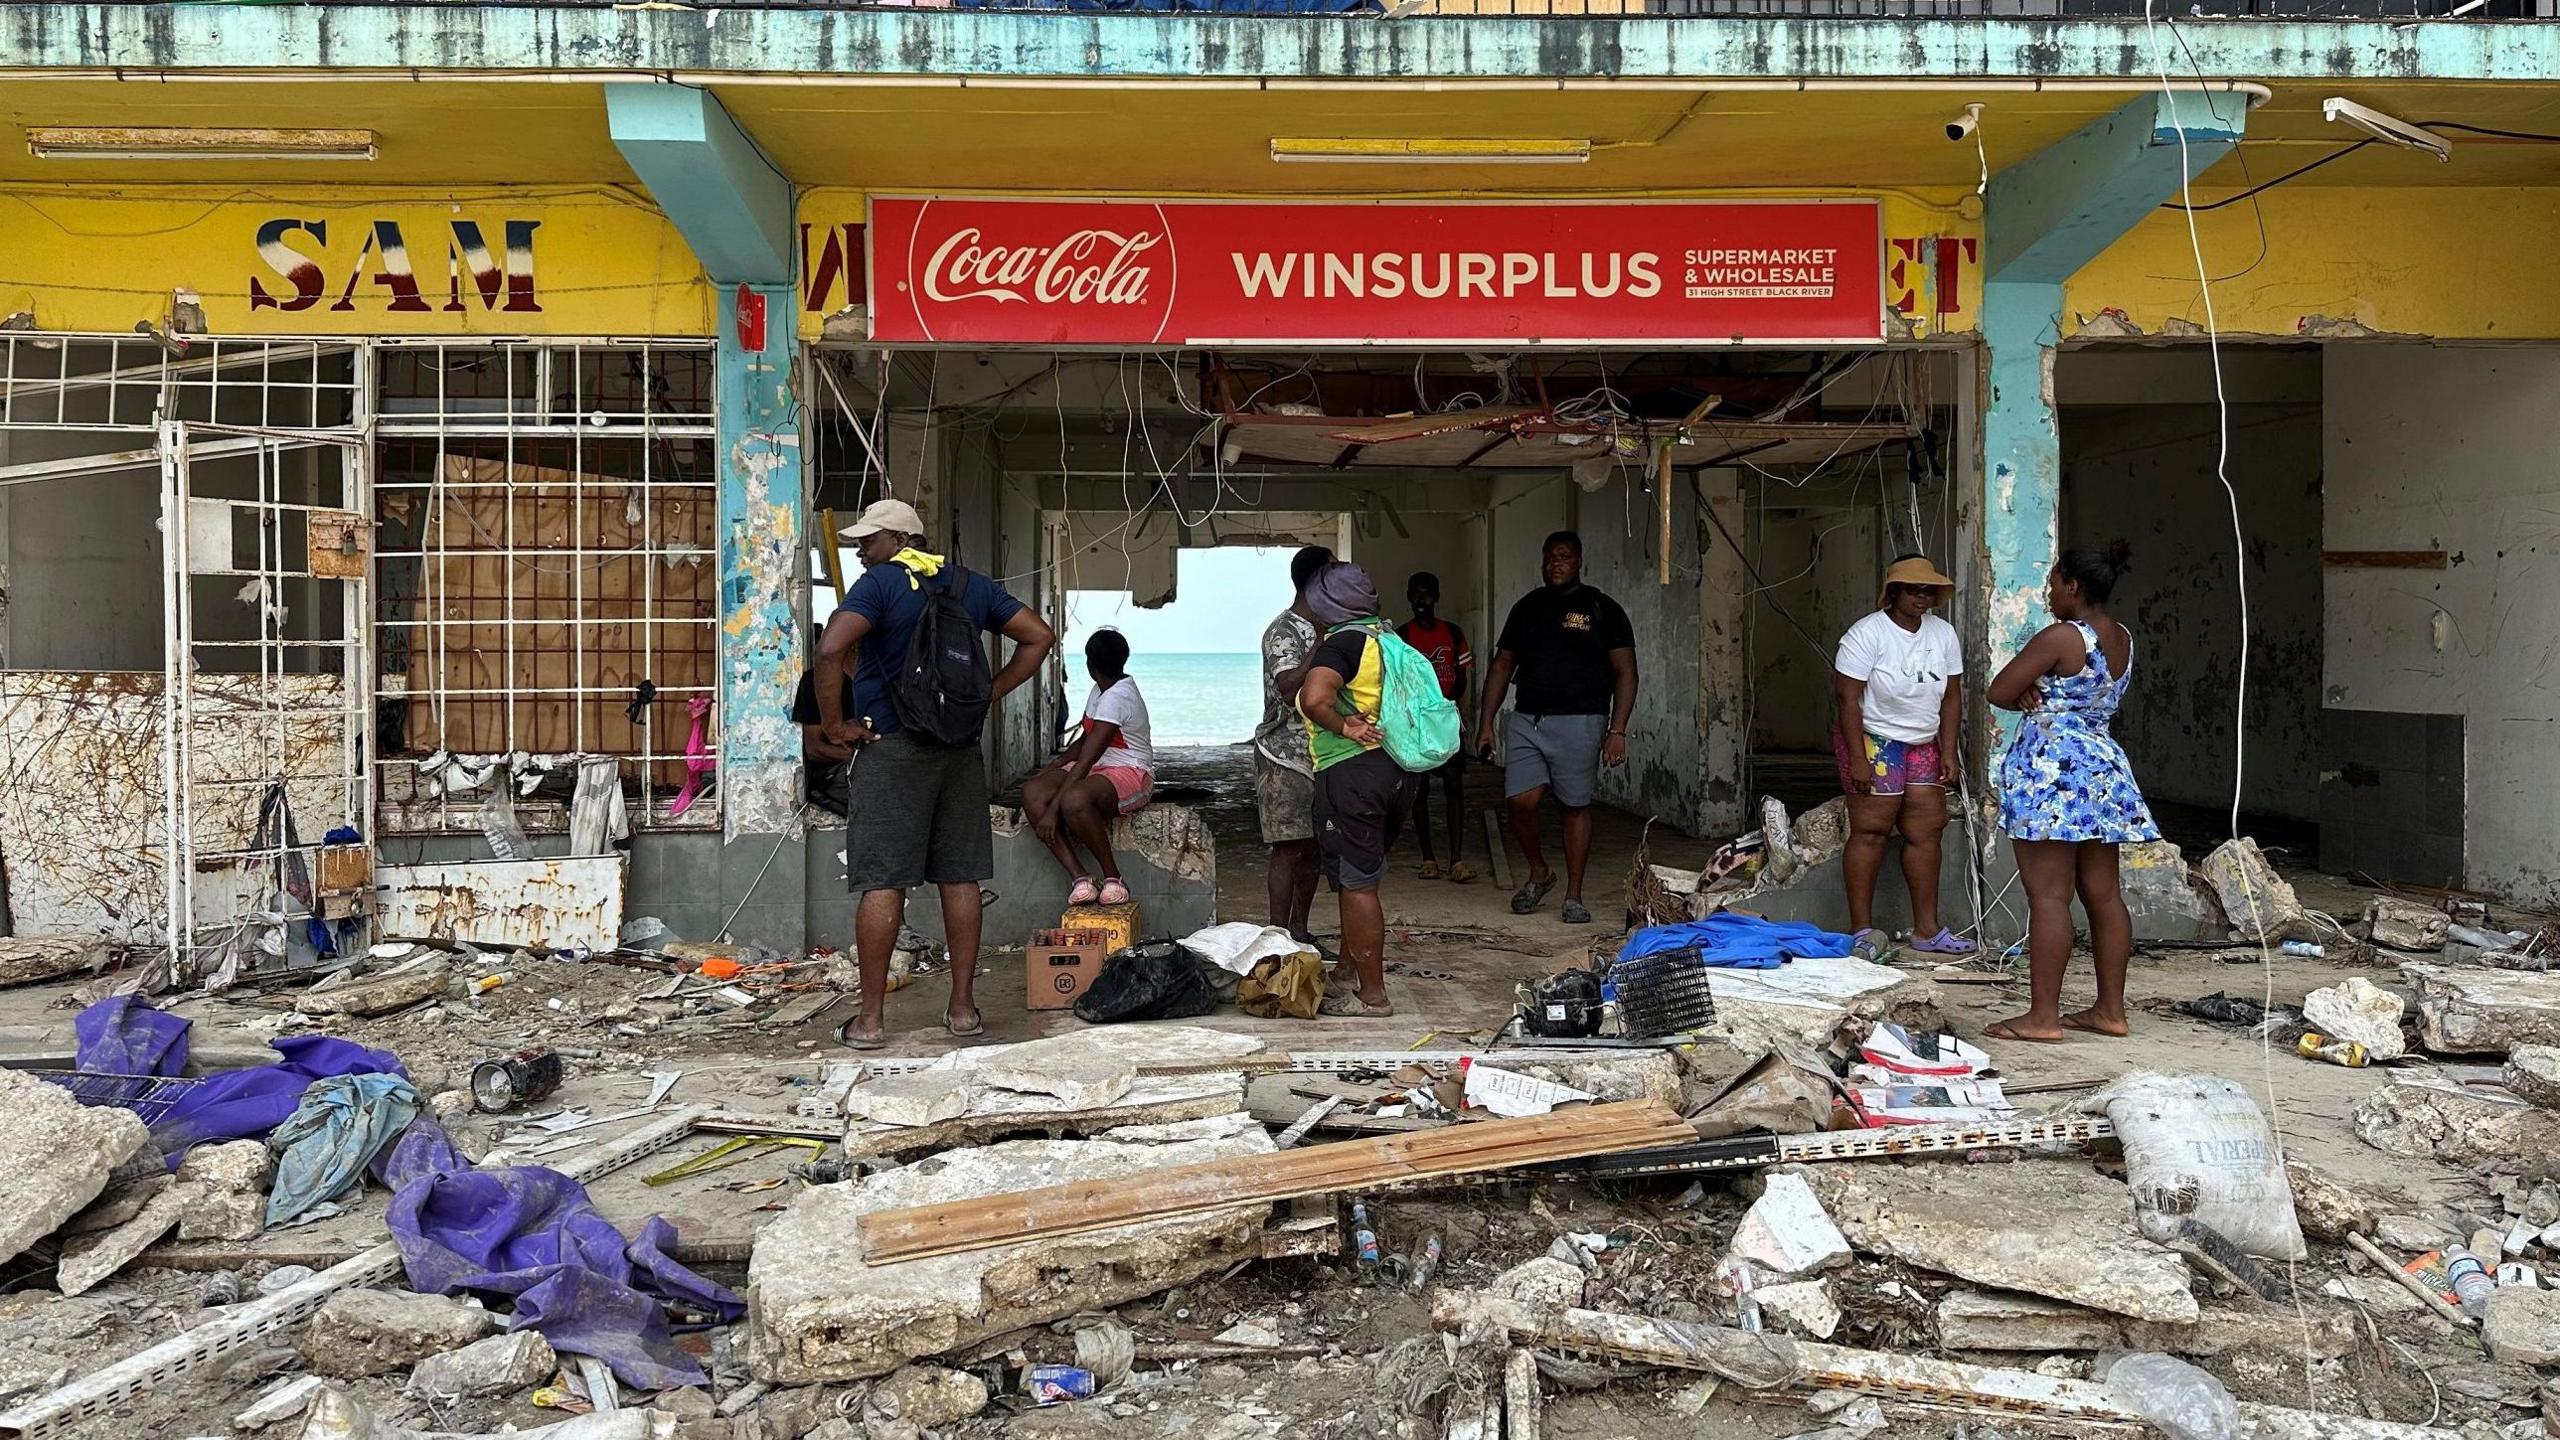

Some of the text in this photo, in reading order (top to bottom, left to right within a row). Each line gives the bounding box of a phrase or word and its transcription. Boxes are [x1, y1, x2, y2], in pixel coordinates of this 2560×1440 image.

[250, 219, 543, 312] SAM
[923, 228, 1165, 305] Coca-Cola
[1685, 249, 1837, 265] SUPERMARKET
[1231, 252, 1663, 299] WINSURPLUS
[1684, 267, 1835, 284] & WHOLESALE
[1688, 287, 1831, 297] 31 HIGH STREET BLACK RIVER
